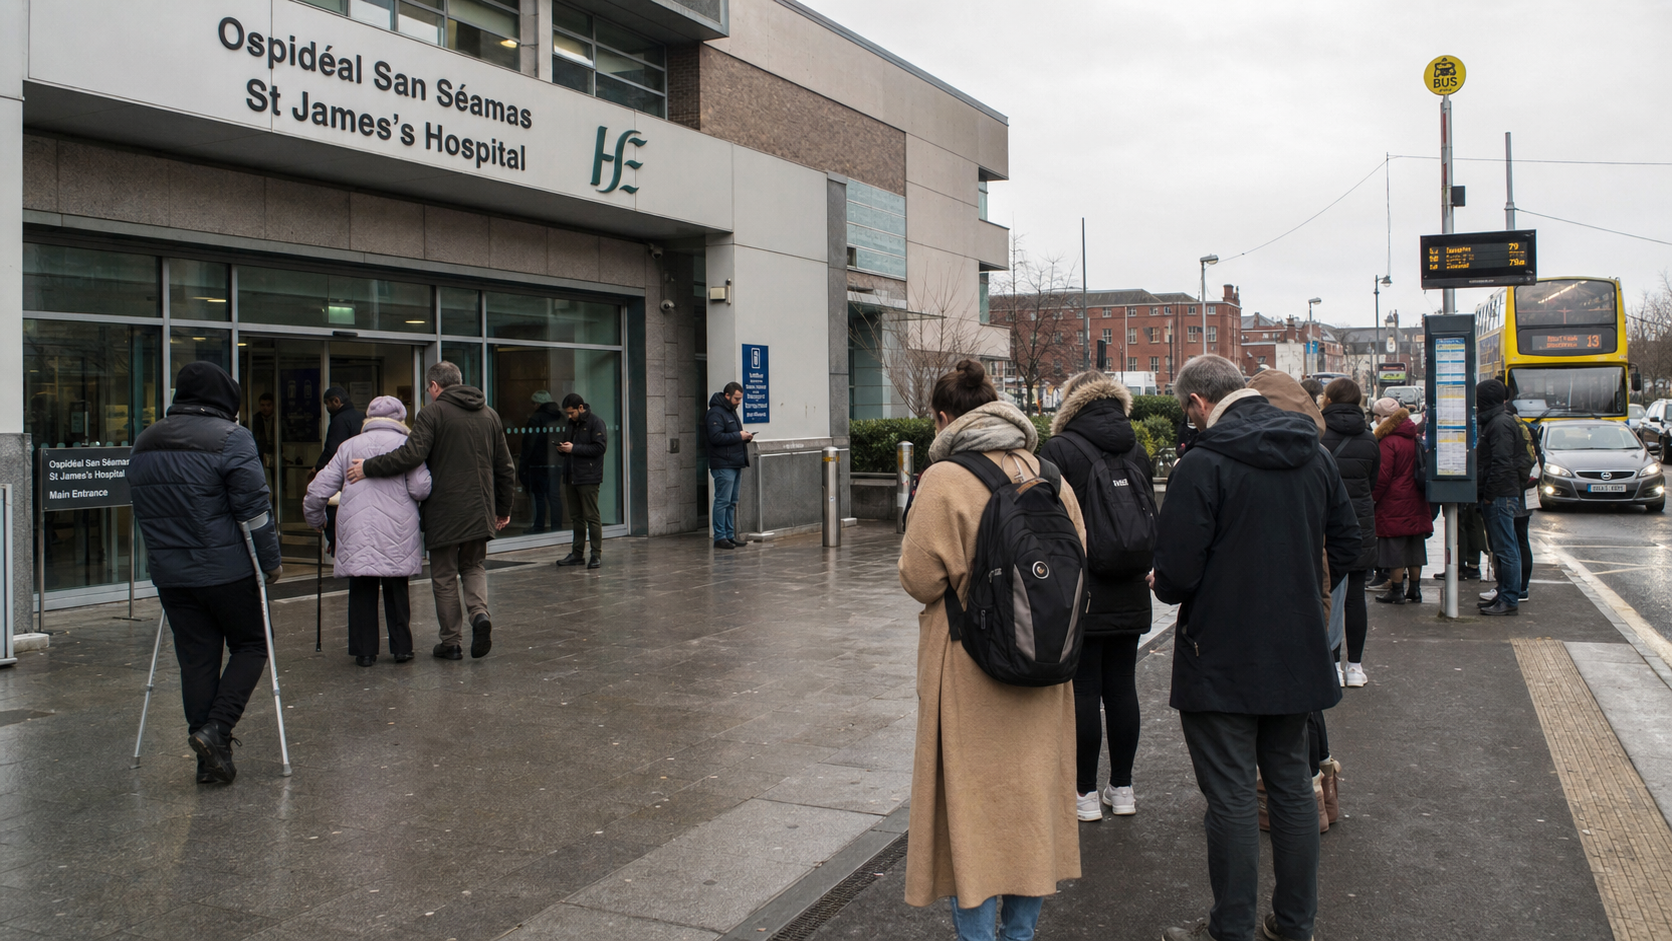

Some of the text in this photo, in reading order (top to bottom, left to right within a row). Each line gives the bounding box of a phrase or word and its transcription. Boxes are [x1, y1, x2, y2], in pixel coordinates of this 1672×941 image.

[218, 16, 532, 130] Ospidéal San Séamas
[1433, 76, 1458, 89] BUS
[246, 78, 281, 117] St
[425, 121, 526, 171] Hospital
[1508, 242, 1519, 250] 79
[1586, 334, 1600, 348] 13
[48, 458, 84, 470] Ospidéal
[85, 458, 101, 468] San
[49, 471, 59, 481] St
[94, 469, 126, 480] Hospital
[49, 488, 109, 500] Main Entrance
